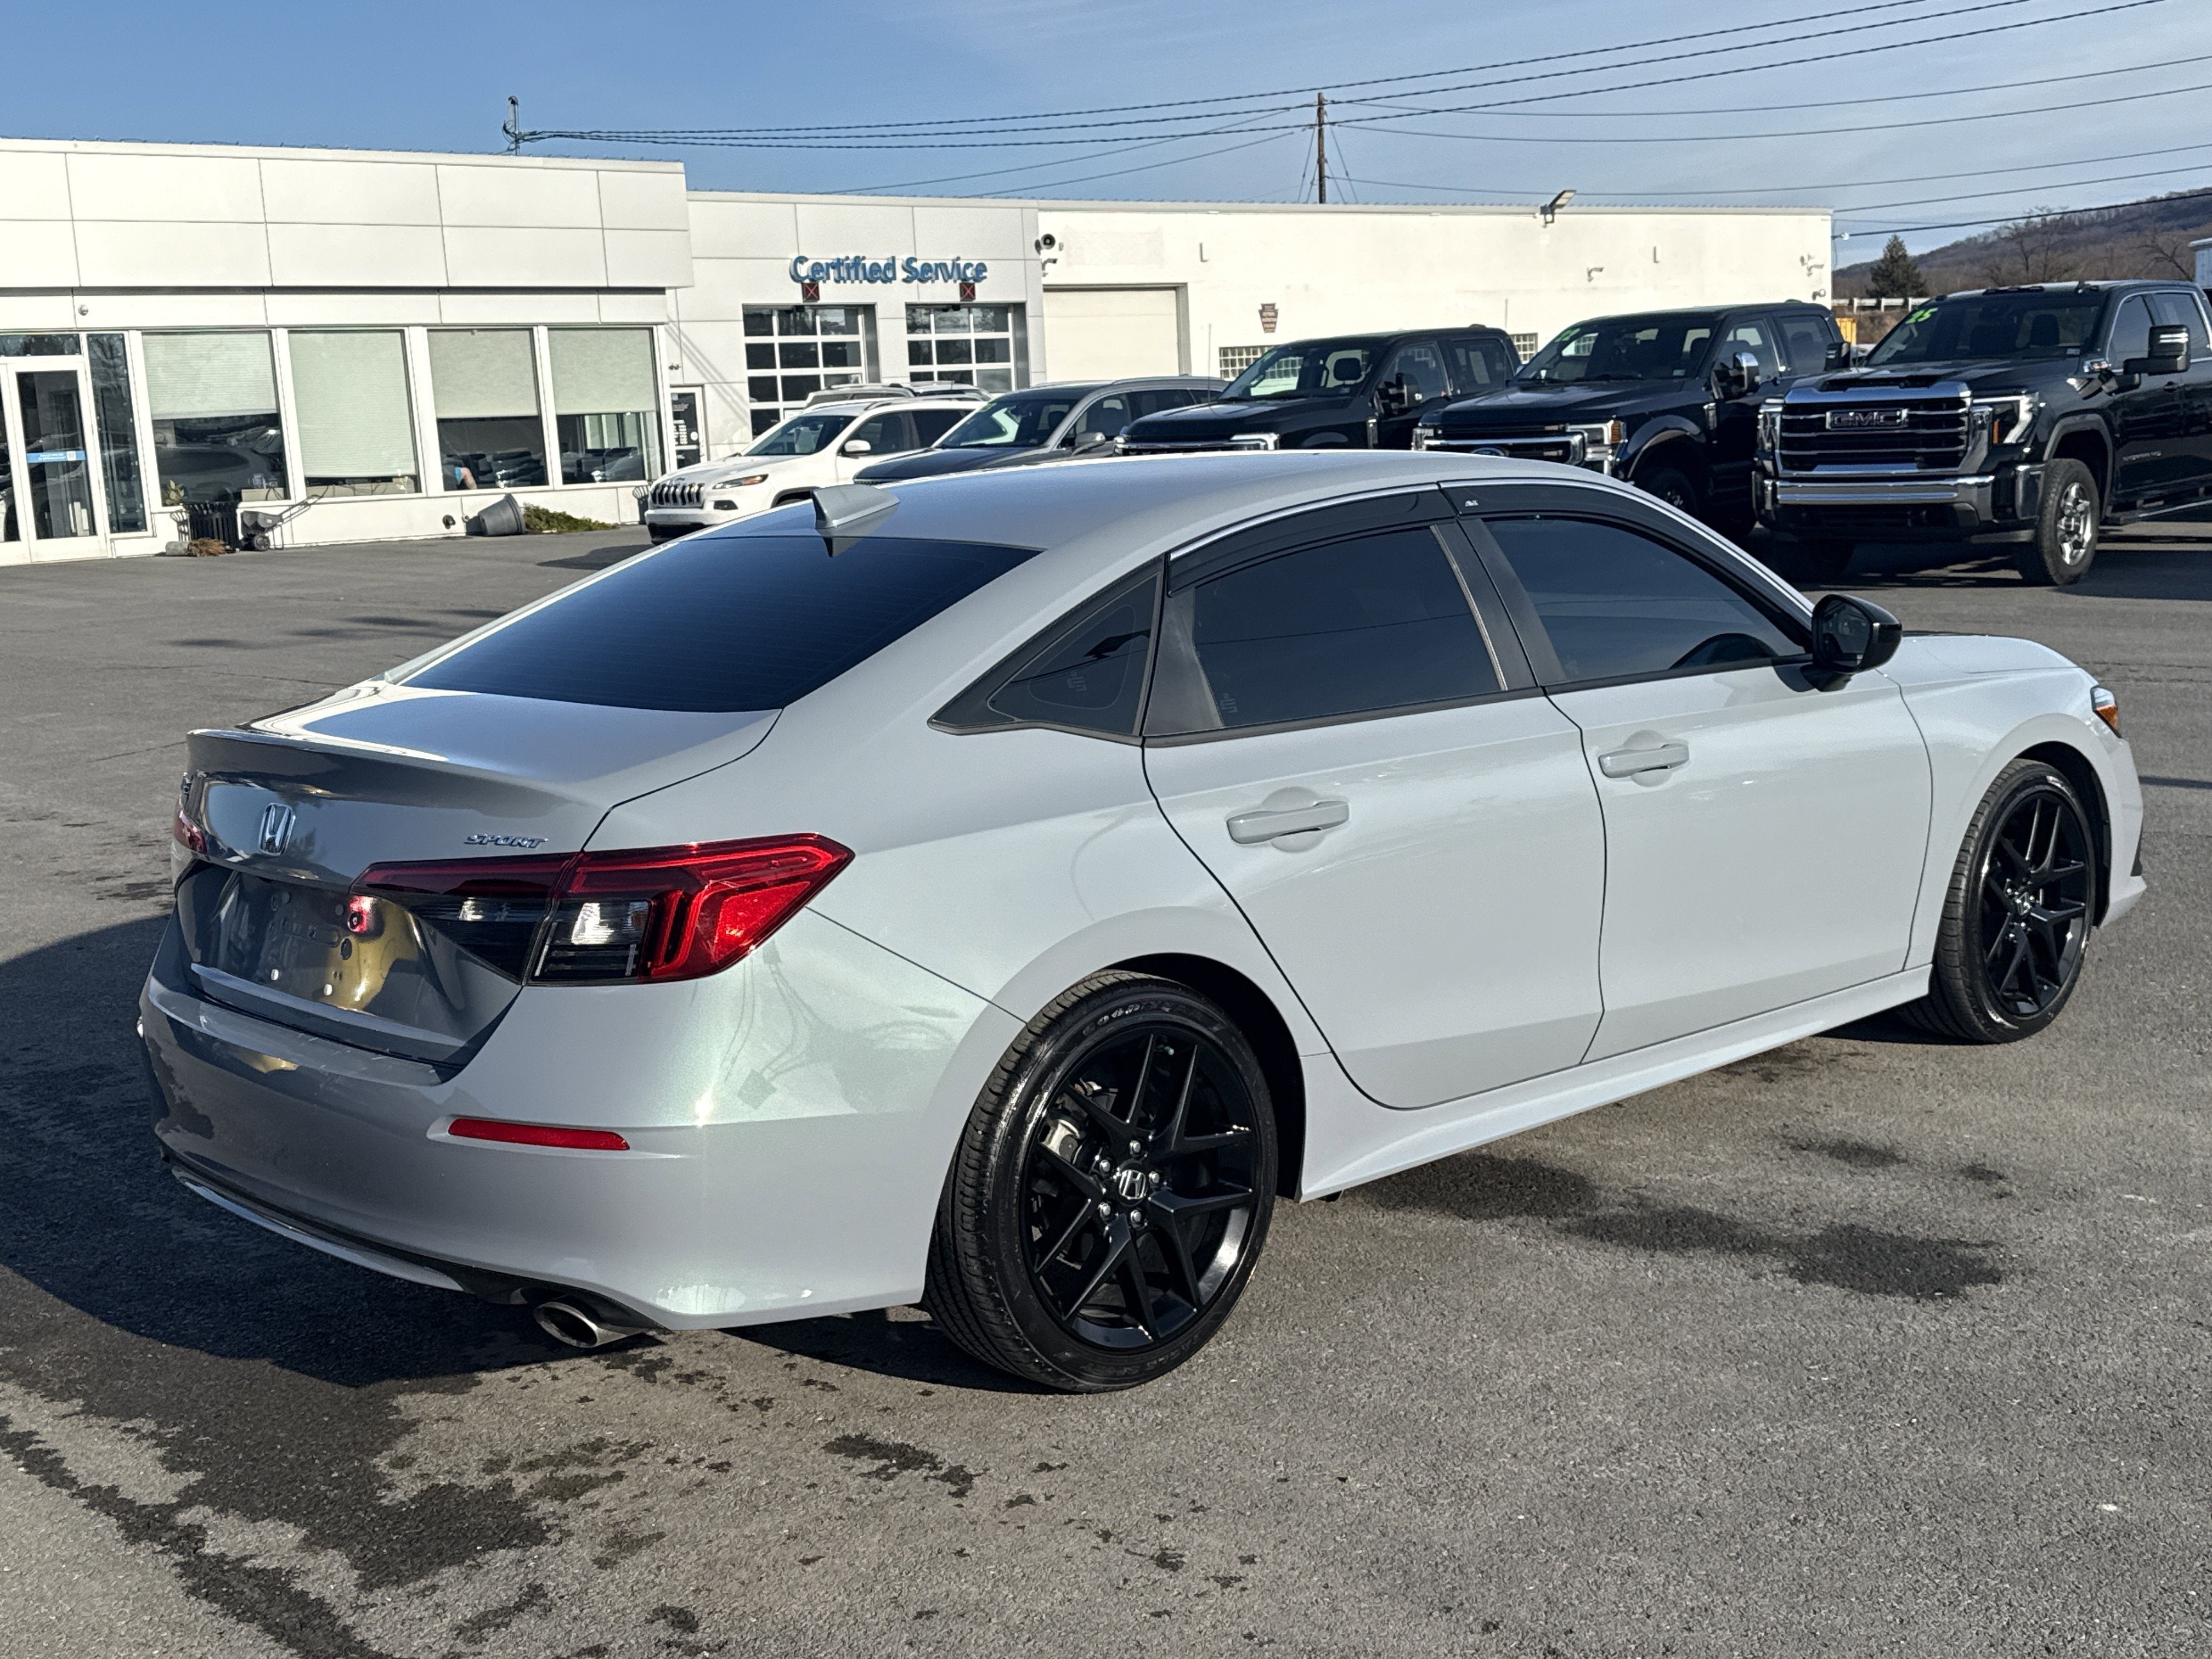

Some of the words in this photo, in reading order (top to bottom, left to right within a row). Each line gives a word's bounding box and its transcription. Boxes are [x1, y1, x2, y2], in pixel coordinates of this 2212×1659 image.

[789, 255, 897, 284] Certified
[901, 256, 988, 284] Service
[1905, 307, 1939, 324] 25
[1831, 411, 1902, 427] GMC
[464, 833, 549, 849] SPORT
